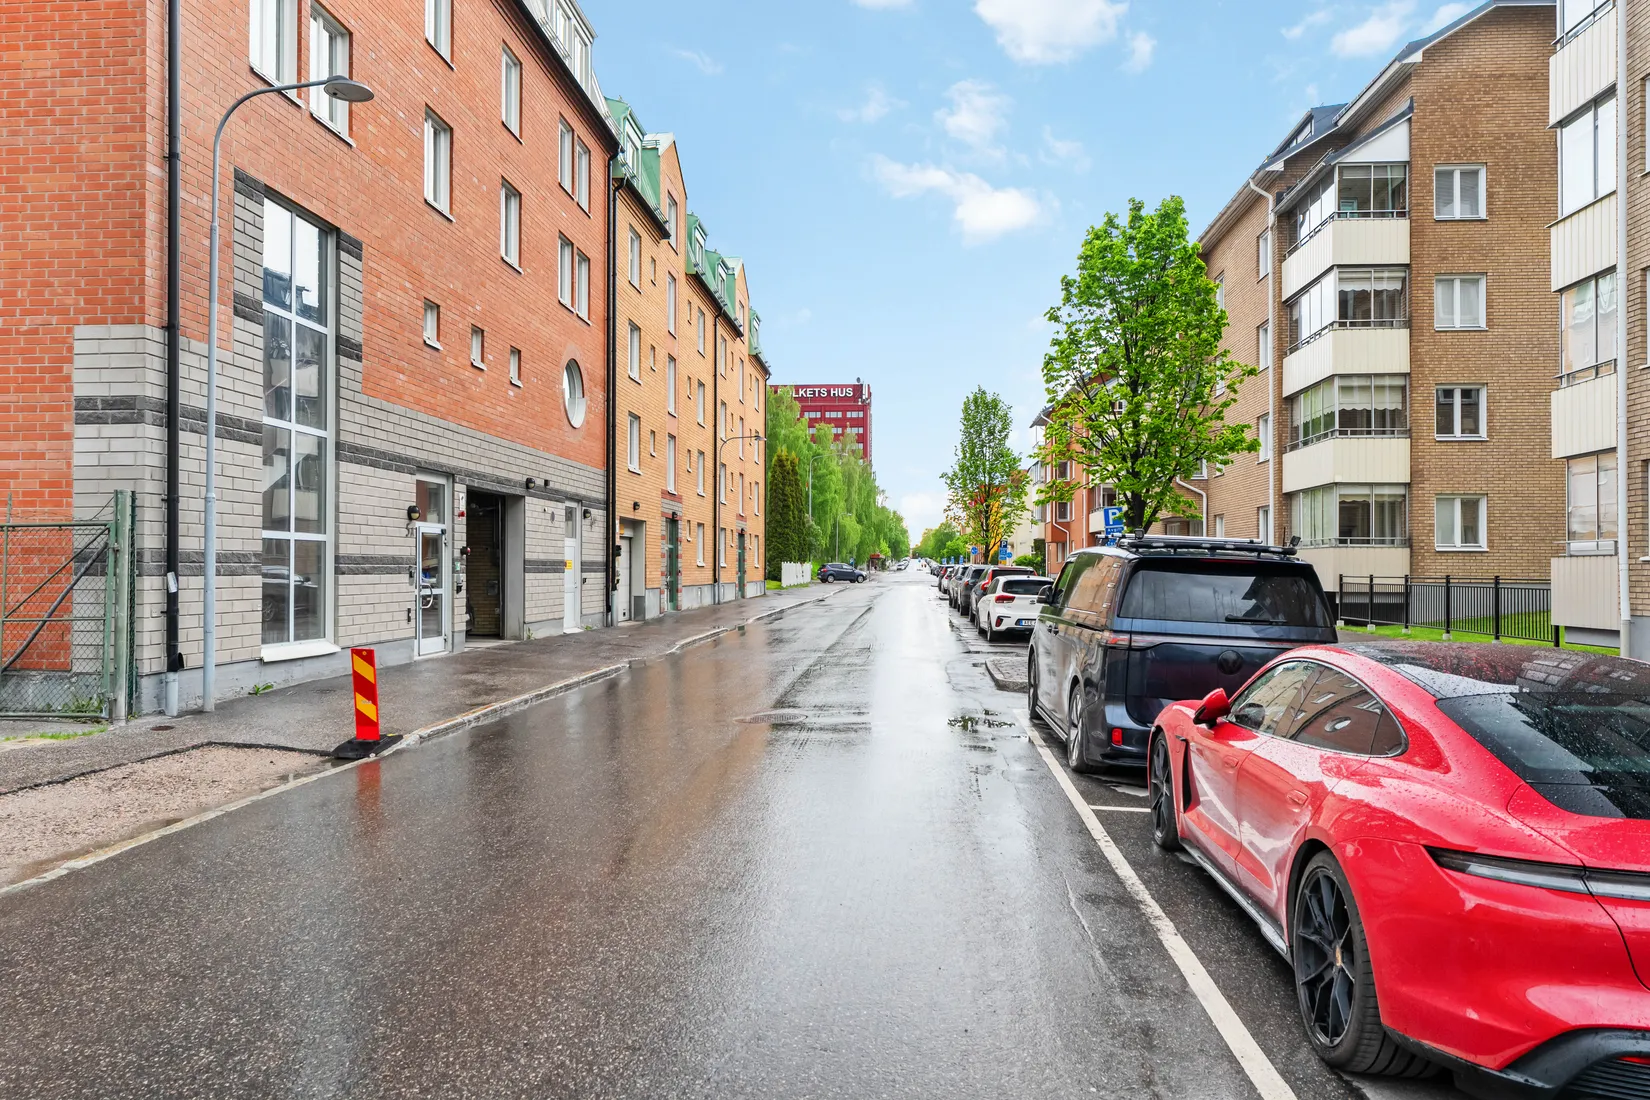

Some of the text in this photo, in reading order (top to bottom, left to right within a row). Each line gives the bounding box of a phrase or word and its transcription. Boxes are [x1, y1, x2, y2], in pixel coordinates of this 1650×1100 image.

[777, 388, 853, 397] LKETS HUS
[1108, 509, 1120, 525] P
